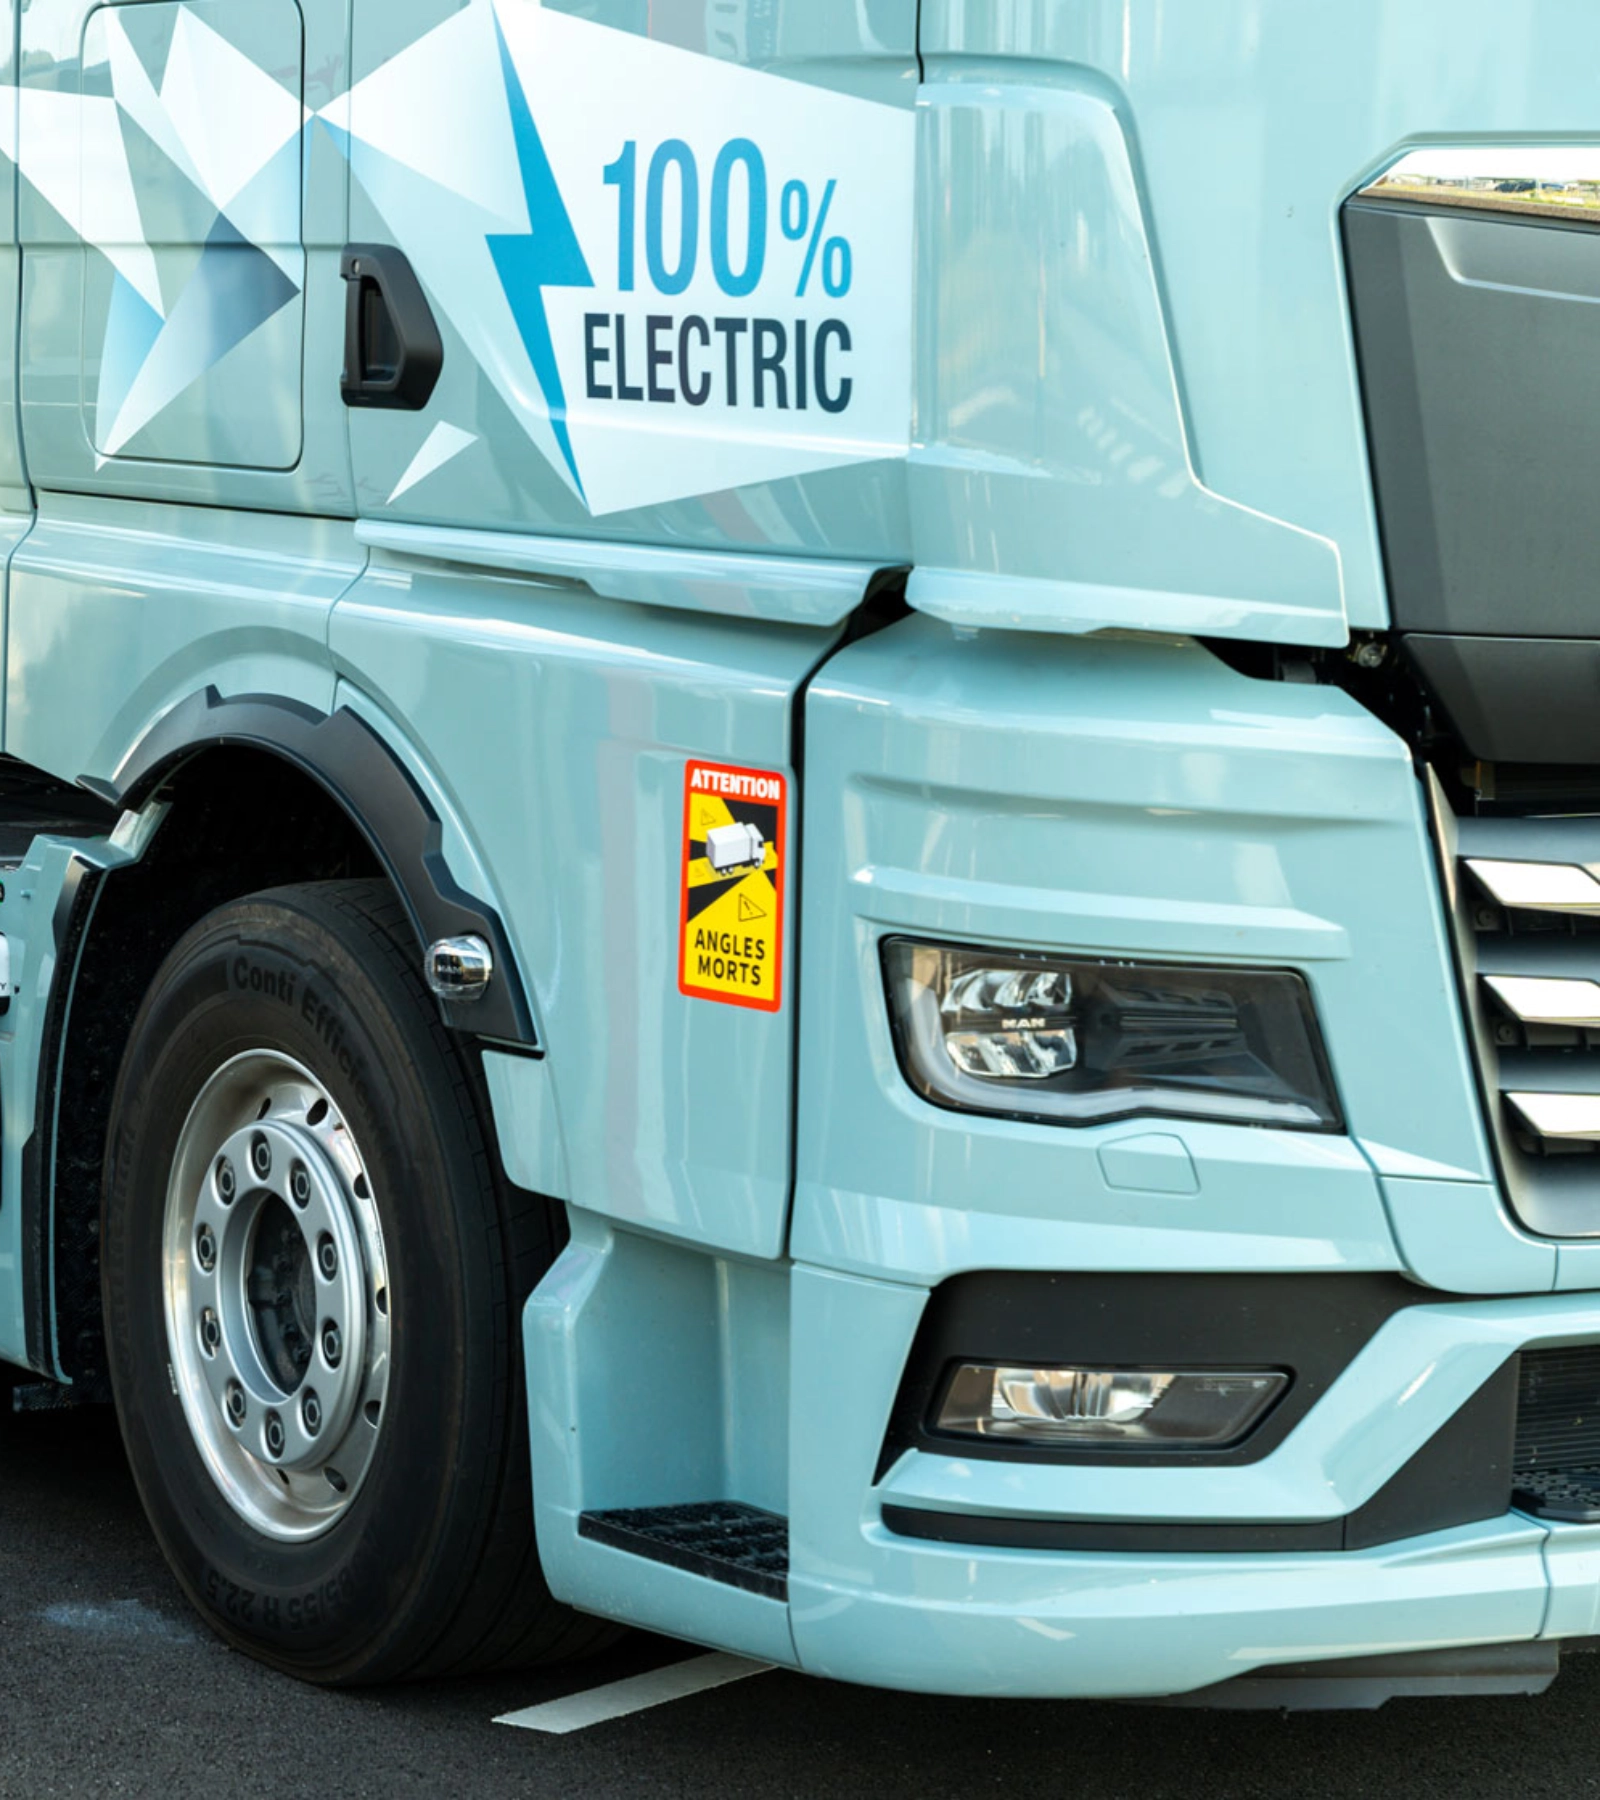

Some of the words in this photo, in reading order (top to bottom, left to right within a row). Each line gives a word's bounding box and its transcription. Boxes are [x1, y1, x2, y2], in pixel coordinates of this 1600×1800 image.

[603, 137, 852, 298] 100%
[584, 313, 853, 414] ELECTRIC
[690, 768, 781, 800] ATTENTION
[694, 928, 766, 961] ANGLES
[233, 956, 297, 1007] Conti
[697, 955, 761, 986] MORTS
[1001, 1018, 1047, 1029] MAN
[206, 1569, 257, 1623] 22.5
[263, 1595, 281, 1629] R
